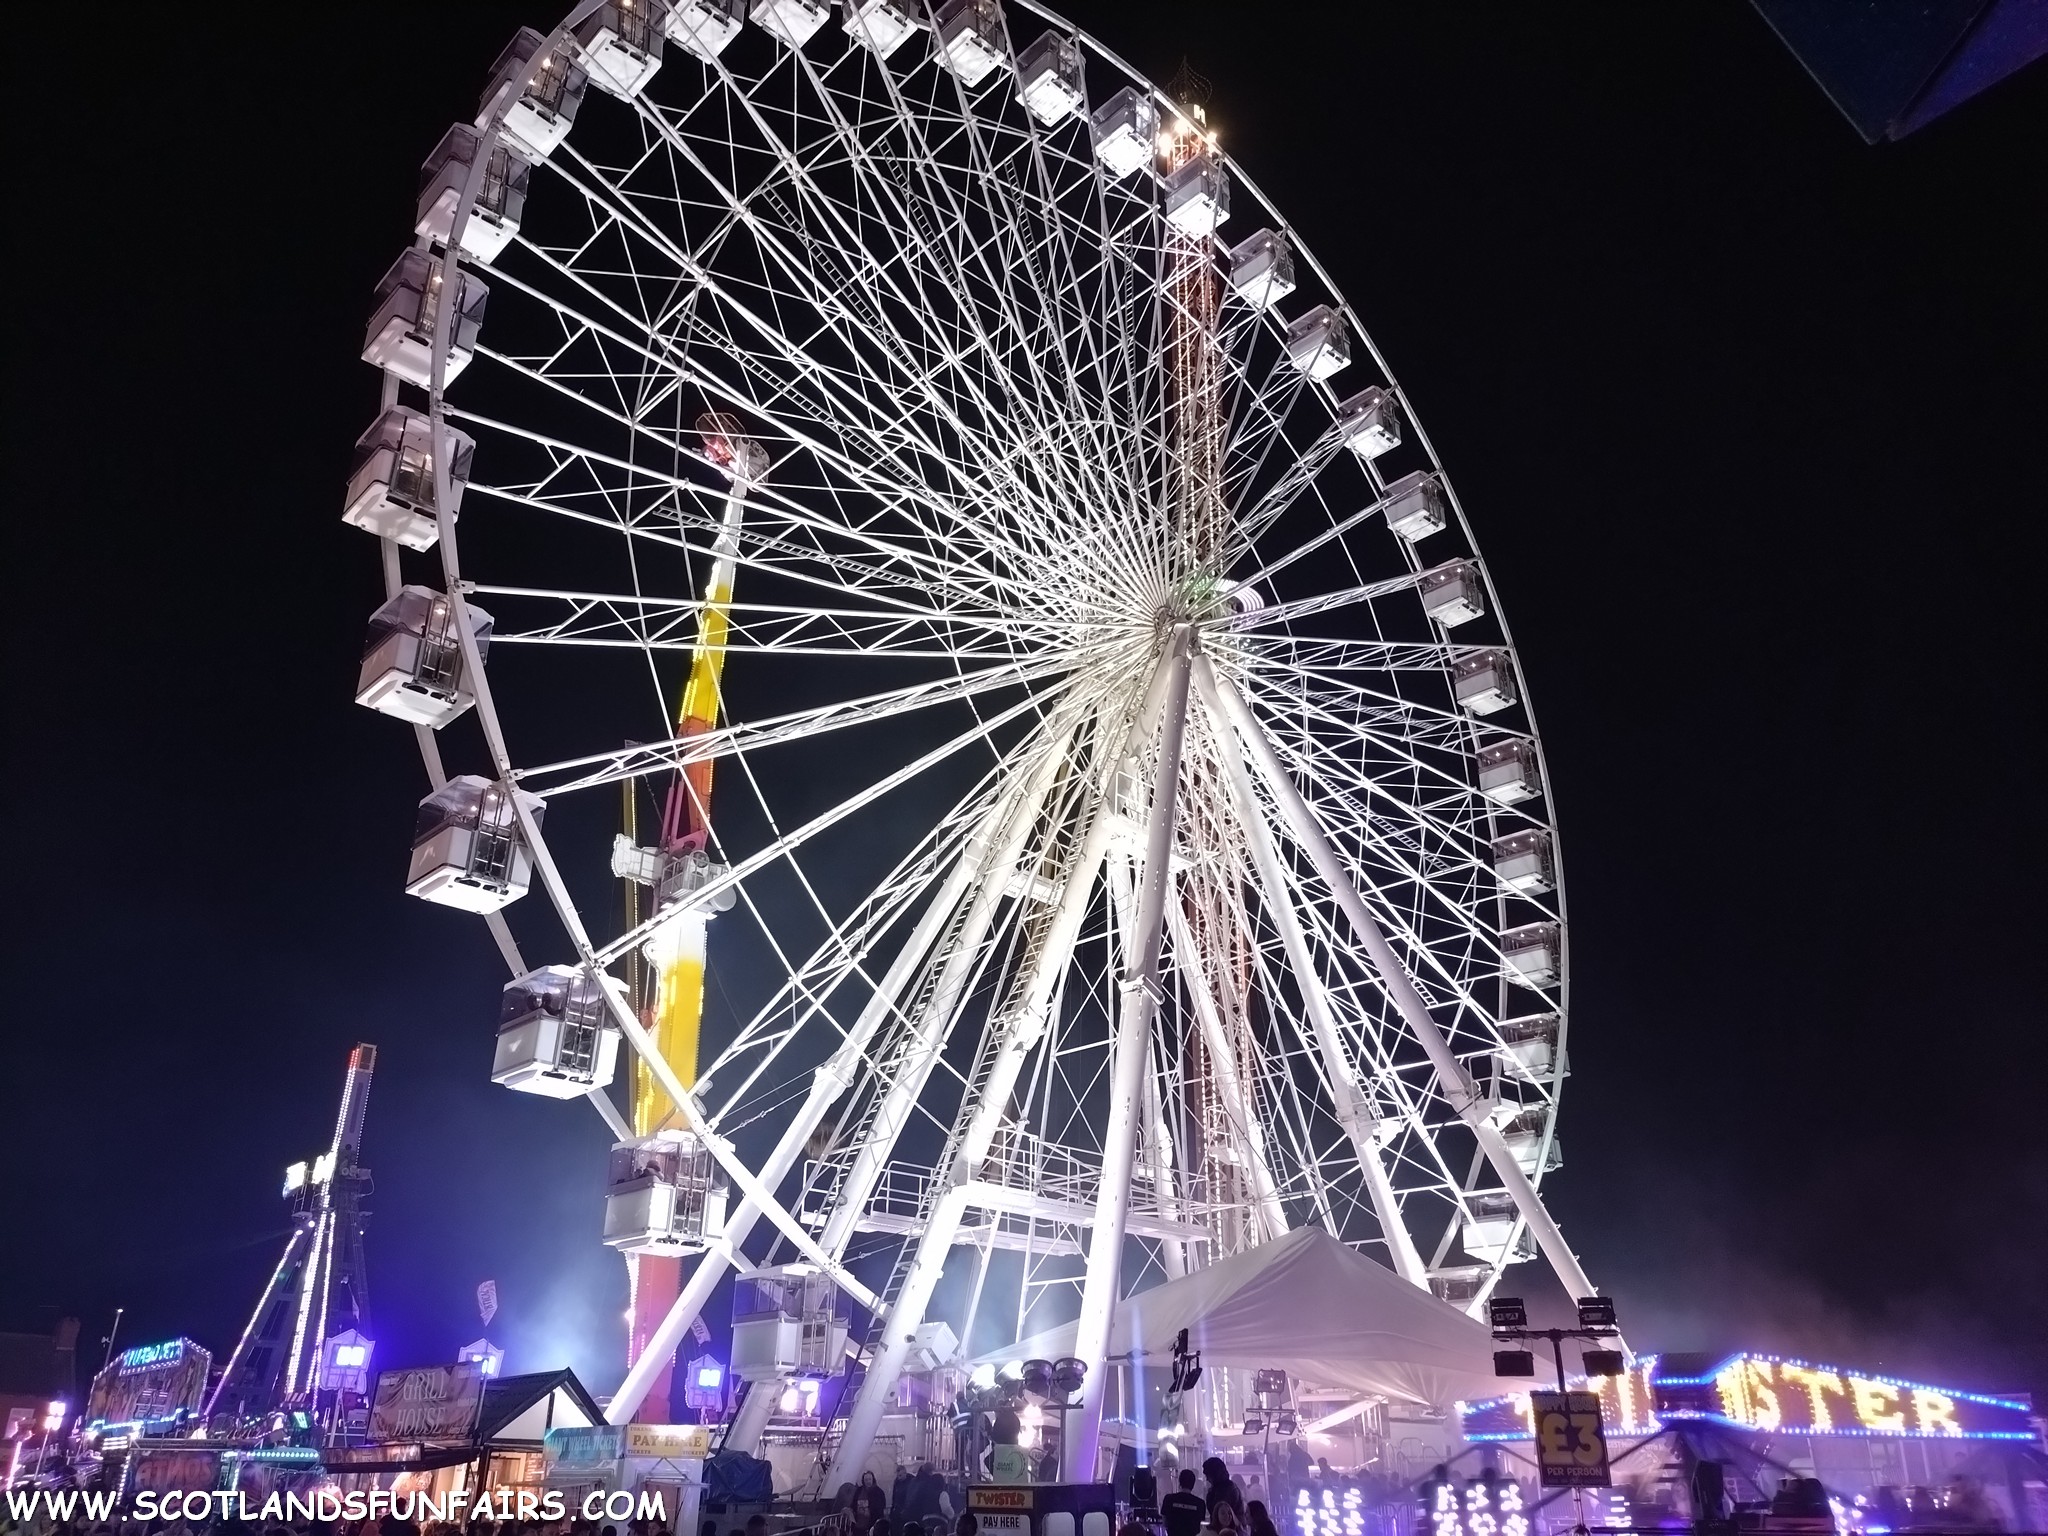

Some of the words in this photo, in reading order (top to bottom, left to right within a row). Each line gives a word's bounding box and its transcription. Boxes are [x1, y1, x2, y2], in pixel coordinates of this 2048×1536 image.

[403, 1371, 447, 1401] GRILL
[392, 1407, 446, 1436] HOUSE
[569, 1435, 590, 1451] WHEEL
[592, 1434, 621, 1451] TICKETS
[633, 1434, 660, 1447] PAY
[1540, 1413, 1604, 1466] £3
[1547, 1467, 1564, 1476] PER
[1567, 1467, 1603, 1476] PERSON
[975, 1492, 1025, 1506] TWISTER
[983, 1516, 999, 1529] PAY
[1000, 1516, 1020, 1529] HERE
